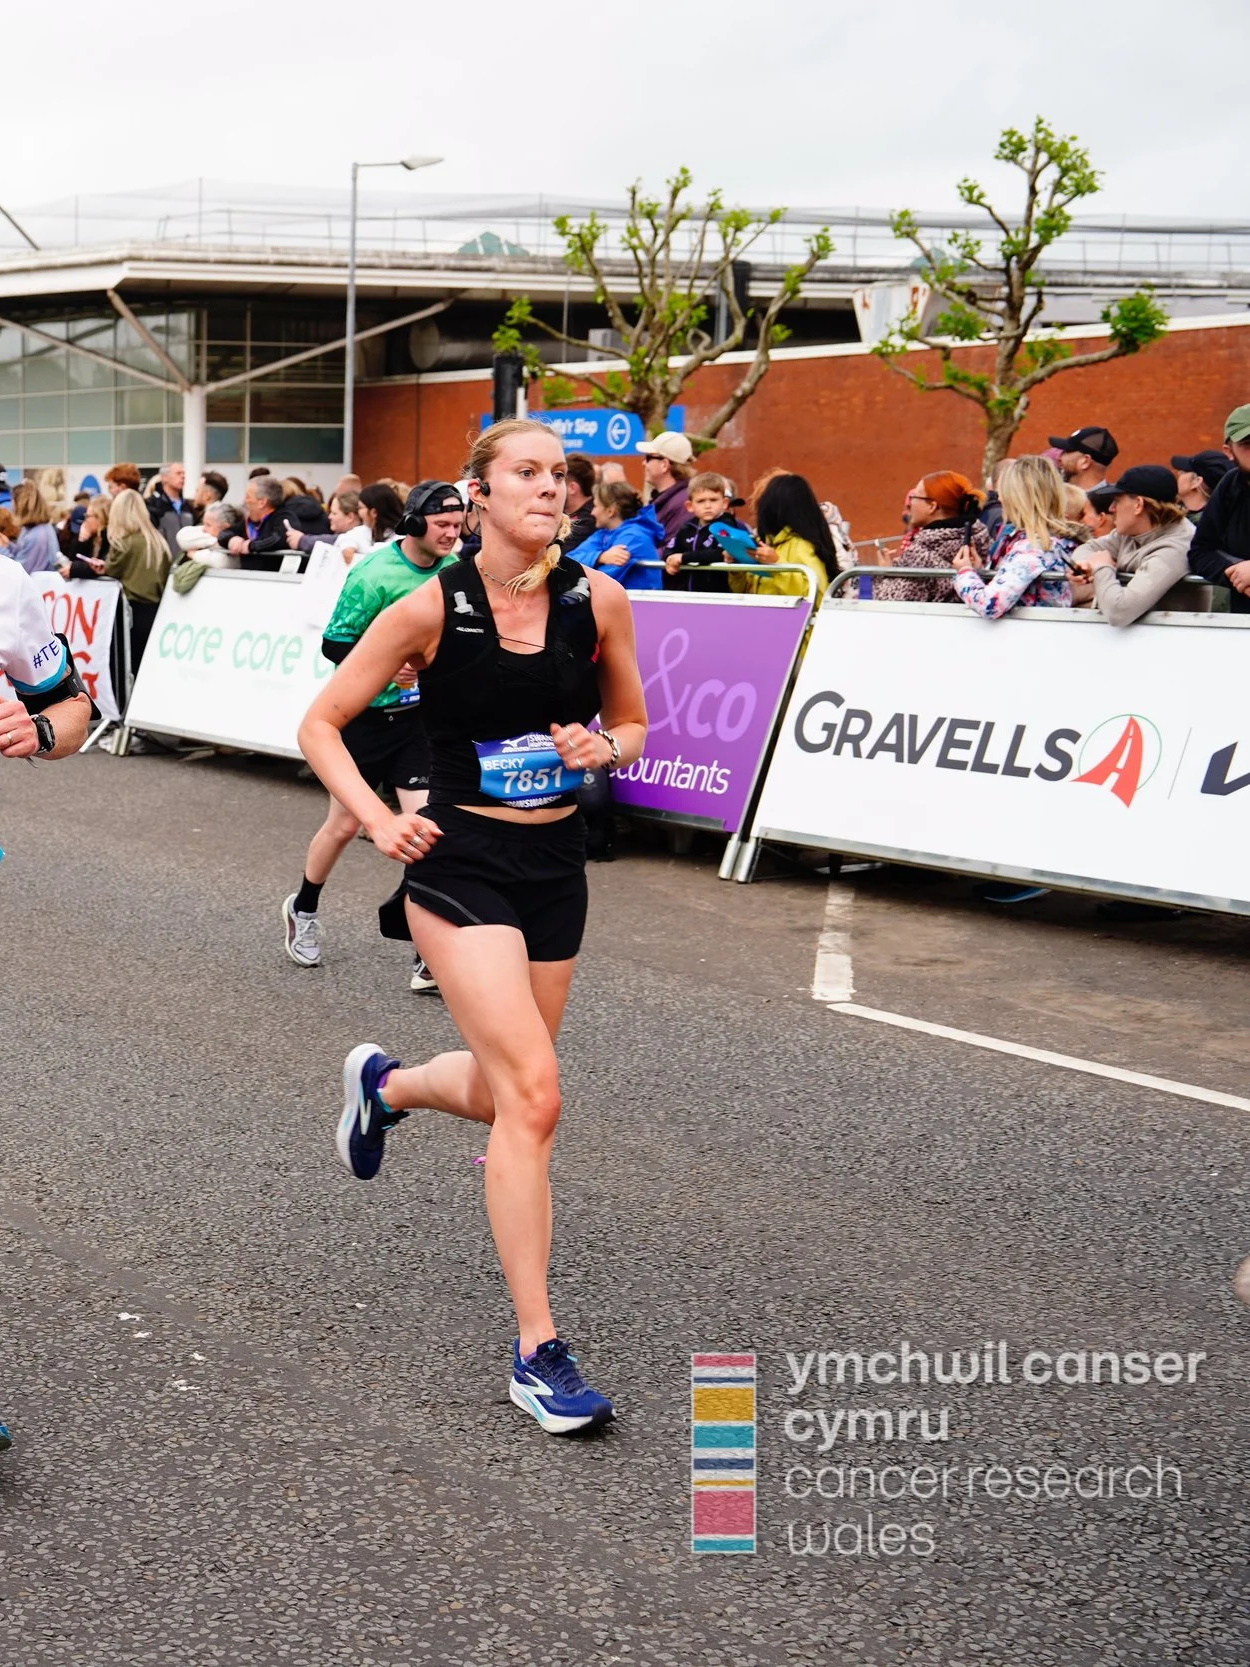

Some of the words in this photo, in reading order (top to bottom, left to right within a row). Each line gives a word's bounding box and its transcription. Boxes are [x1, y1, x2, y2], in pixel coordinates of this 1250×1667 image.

[159, 622, 223, 664] core
[232, 630, 303, 675] core
[794, 690, 1082, 782] GRAVELLS
[483, 757, 526, 771] BECKY
[503, 766, 563, 795] 7851
